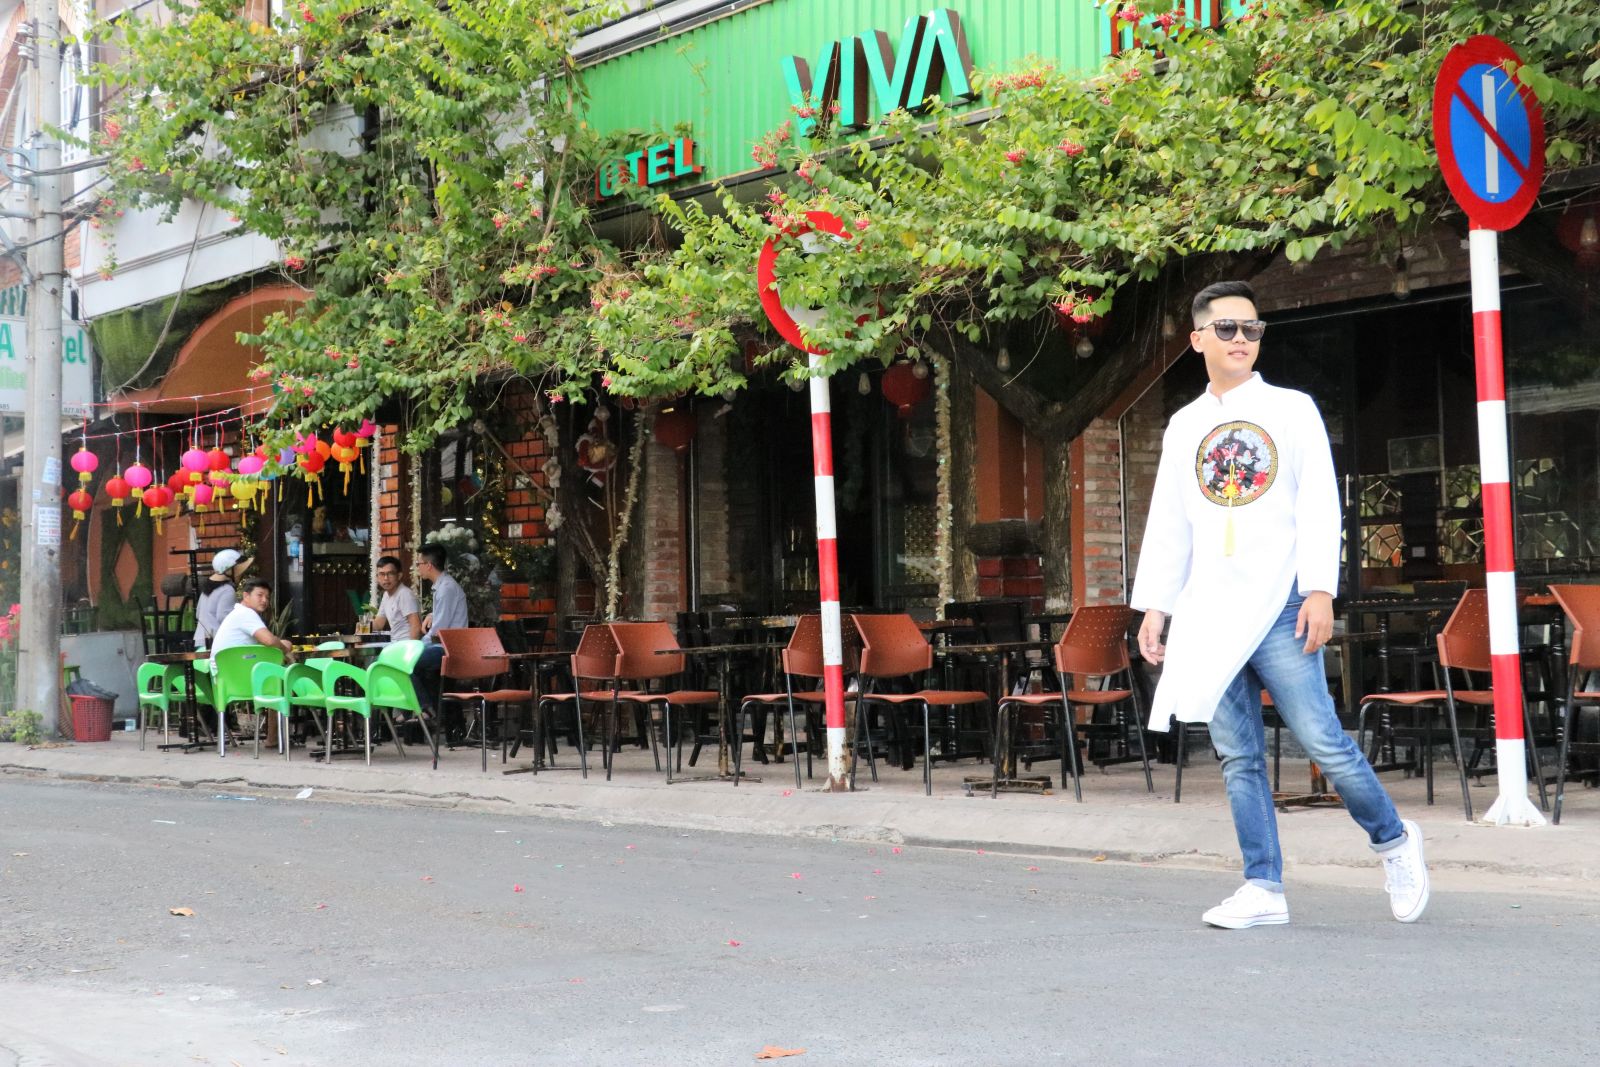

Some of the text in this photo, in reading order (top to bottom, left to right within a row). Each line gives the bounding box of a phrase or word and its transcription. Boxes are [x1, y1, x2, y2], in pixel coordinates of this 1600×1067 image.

[782, 8, 971, 136] VIVA
[594, 136, 702, 199] OTEL
[62, 328, 88, 364] el
